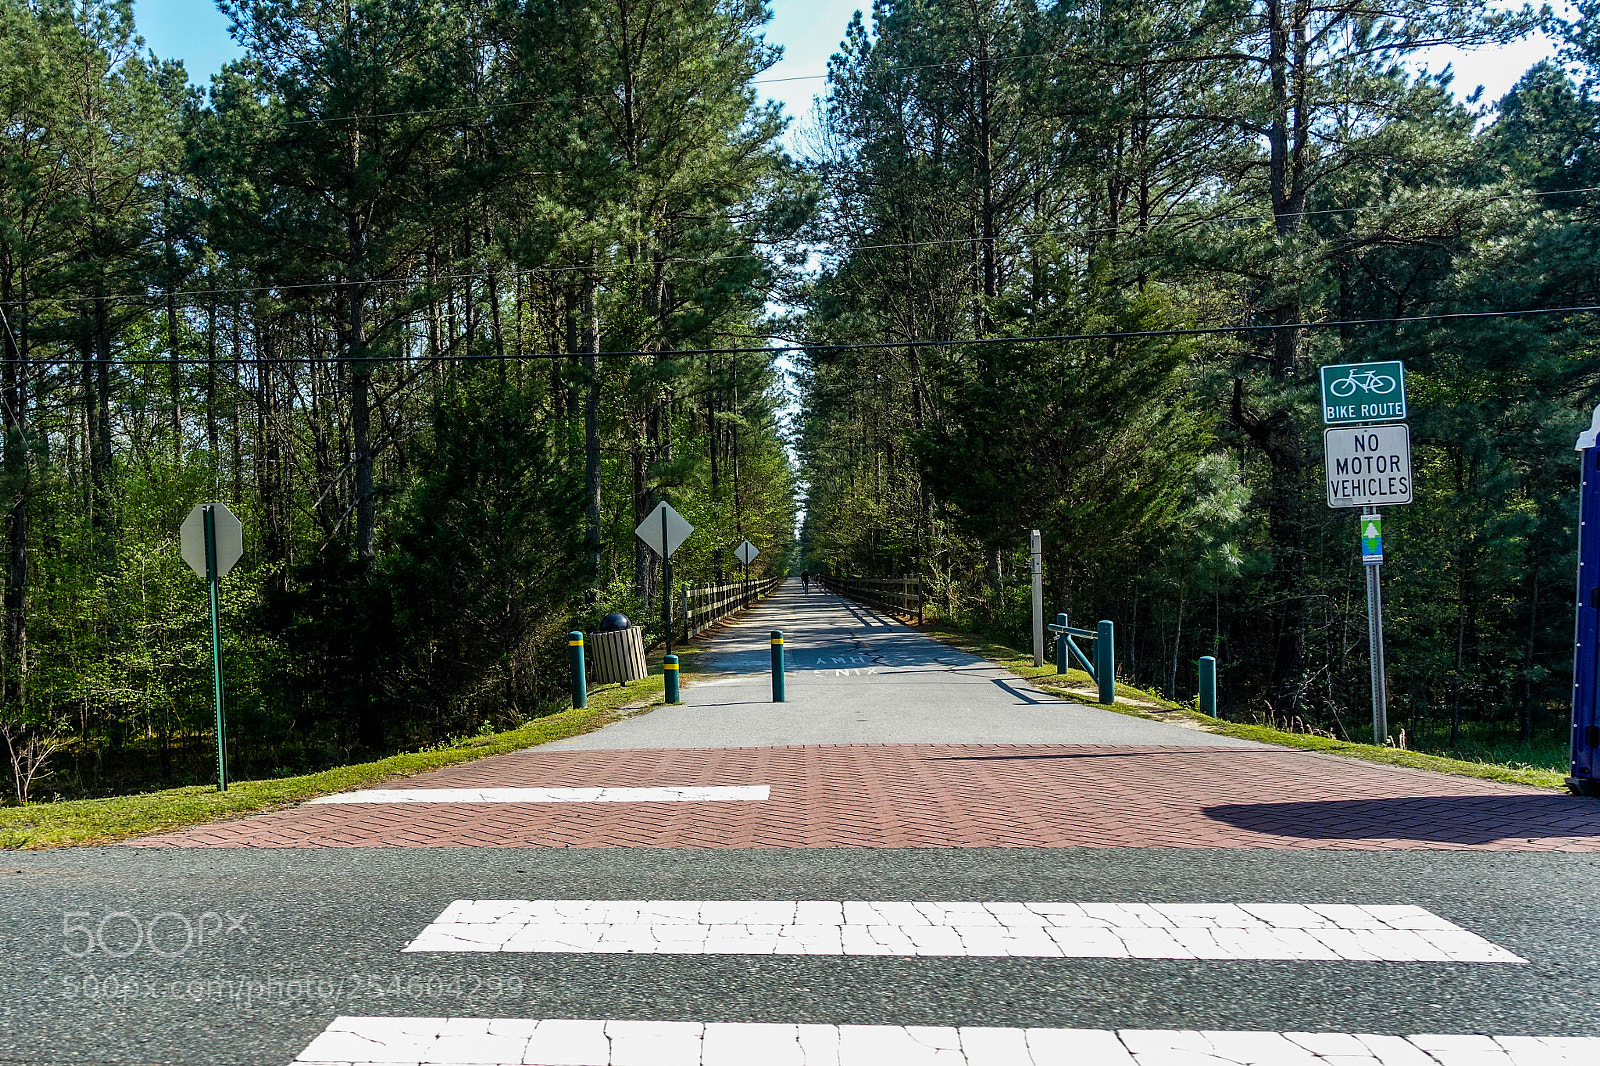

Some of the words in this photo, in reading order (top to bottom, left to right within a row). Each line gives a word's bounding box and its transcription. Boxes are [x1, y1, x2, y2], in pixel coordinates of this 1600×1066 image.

[1326, 405, 1356, 419] BIKE
[1361, 402, 1403, 417] ROUTE
[1354, 433, 1379, 452] NO
[1336, 455, 1401, 475] MOTOR
[1330, 476, 1408, 497] VEHICLES
